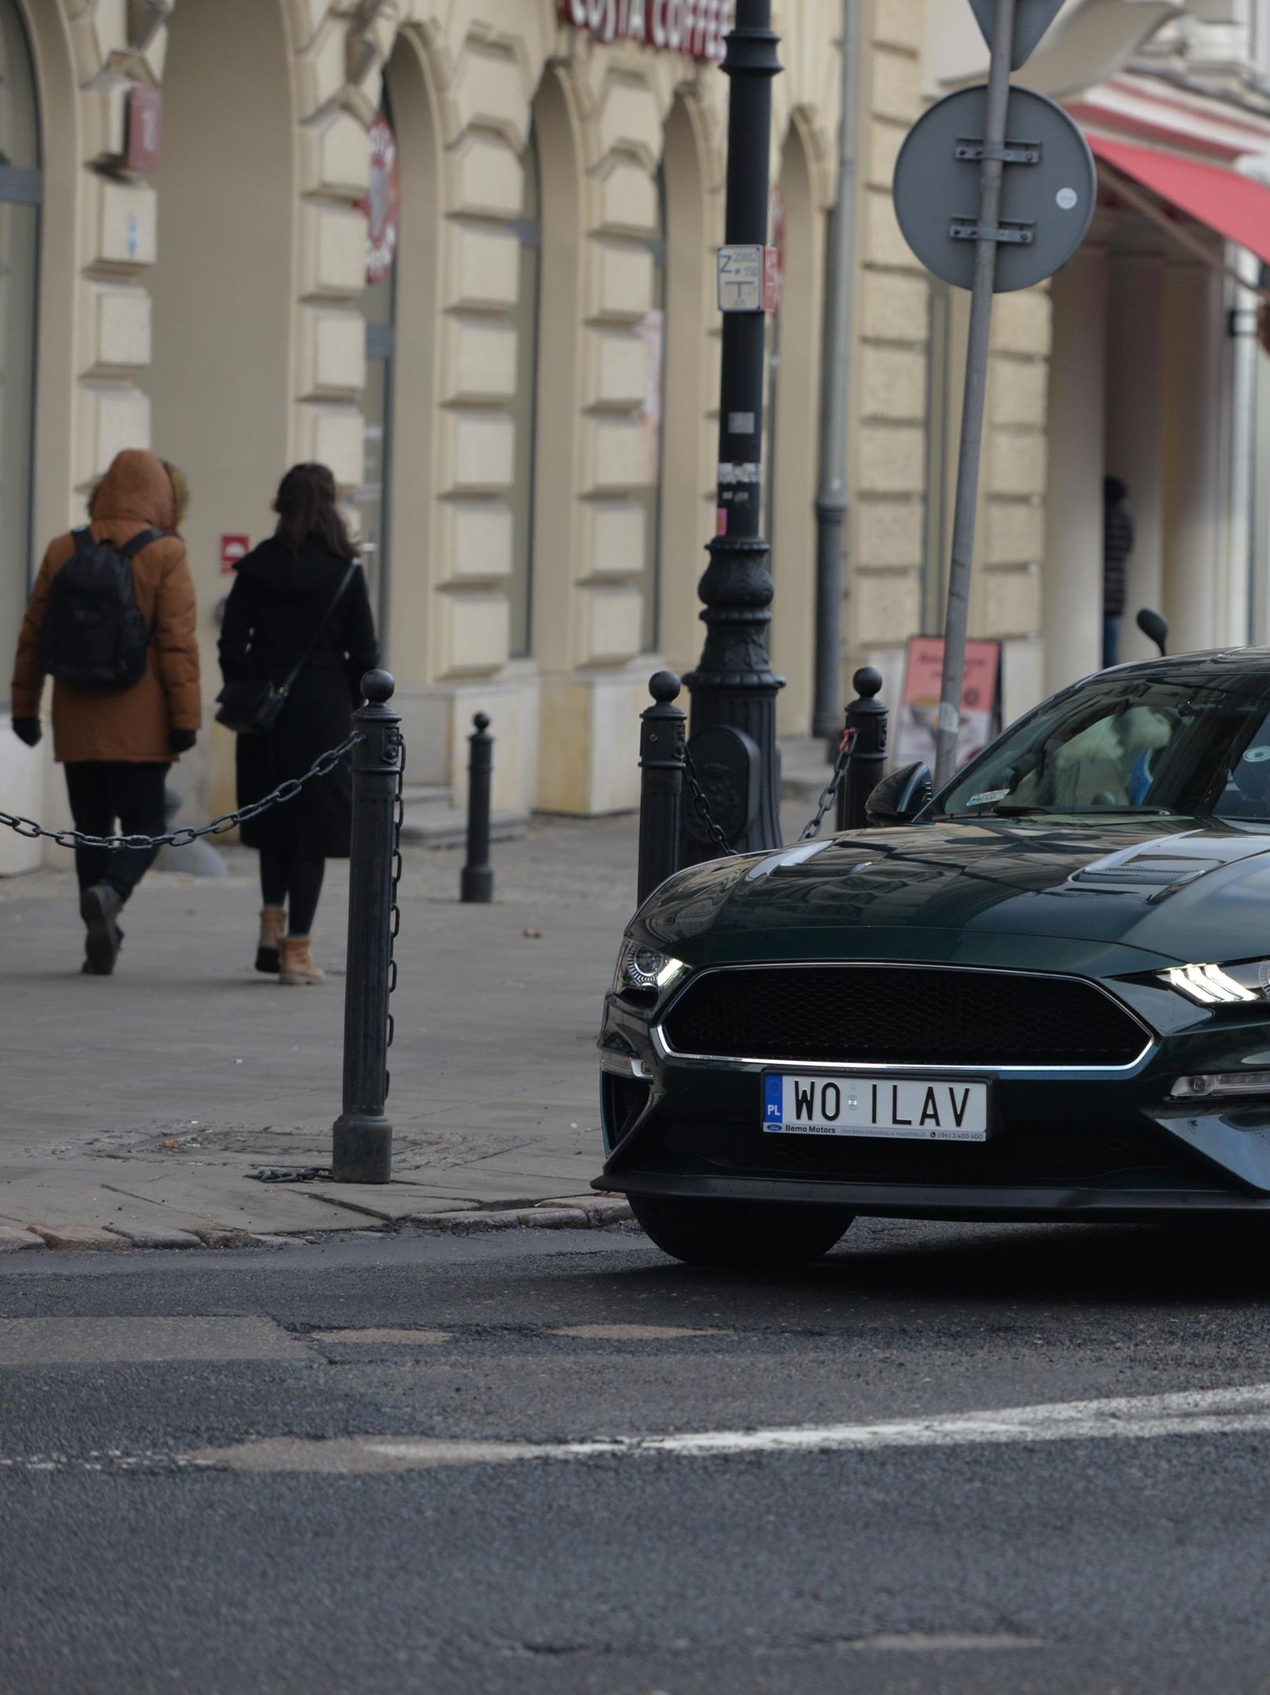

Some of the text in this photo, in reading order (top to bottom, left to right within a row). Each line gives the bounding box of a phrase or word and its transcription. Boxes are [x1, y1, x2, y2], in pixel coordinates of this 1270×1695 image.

[767, 1104, 781, 1116] PL
[785, 1124, 808, 1134] Bemo
[809, 1125, 836, 1135] Motors
